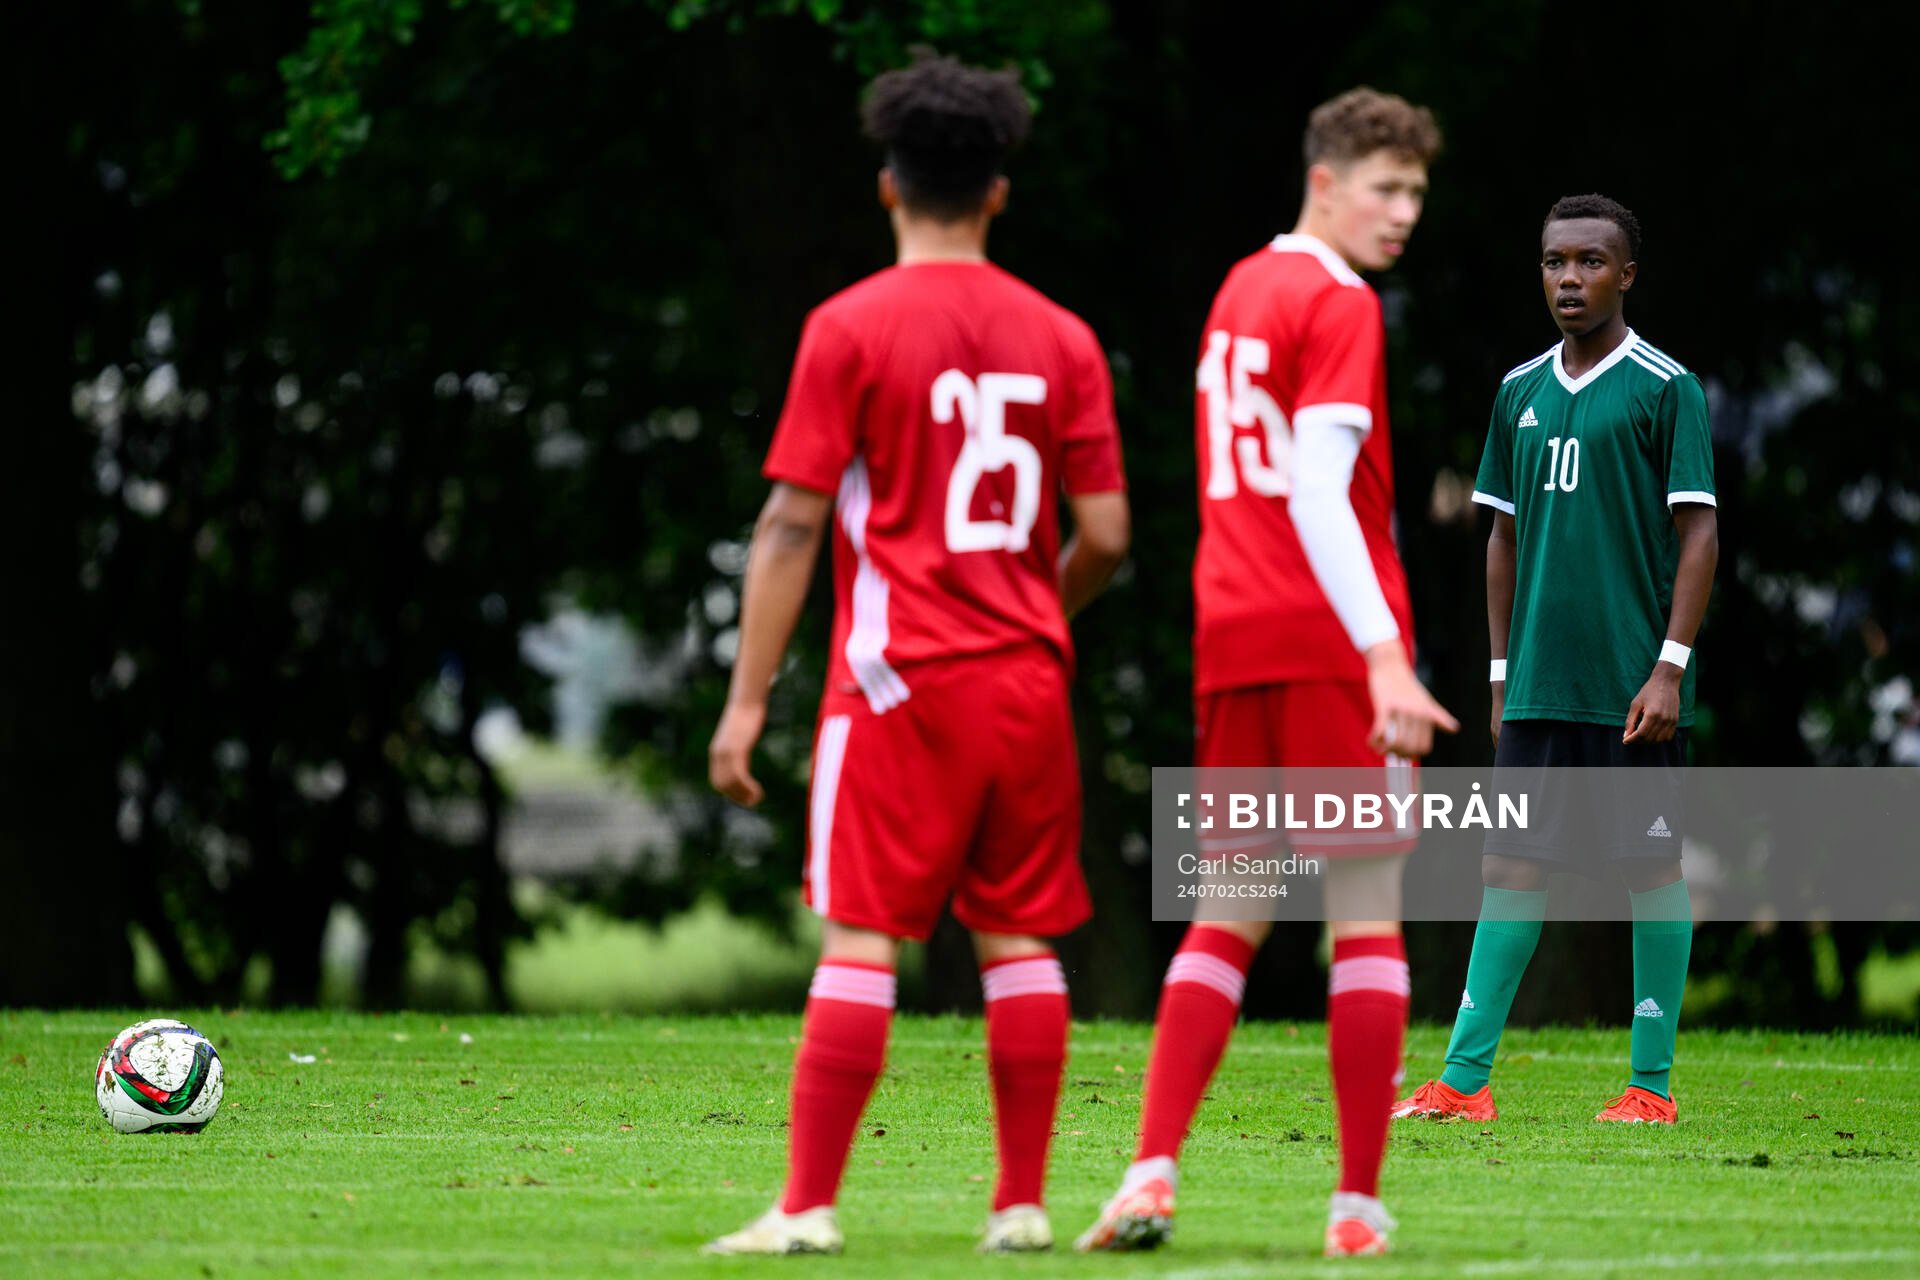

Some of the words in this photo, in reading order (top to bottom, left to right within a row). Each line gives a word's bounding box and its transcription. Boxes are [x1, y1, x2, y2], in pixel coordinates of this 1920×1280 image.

[930, 368, 1048, 553] 25
[1197, 330, 1295, 500] 15
[1544, 437, 1580, 492] 10
[1647, 829, 1672, 838] adidas
